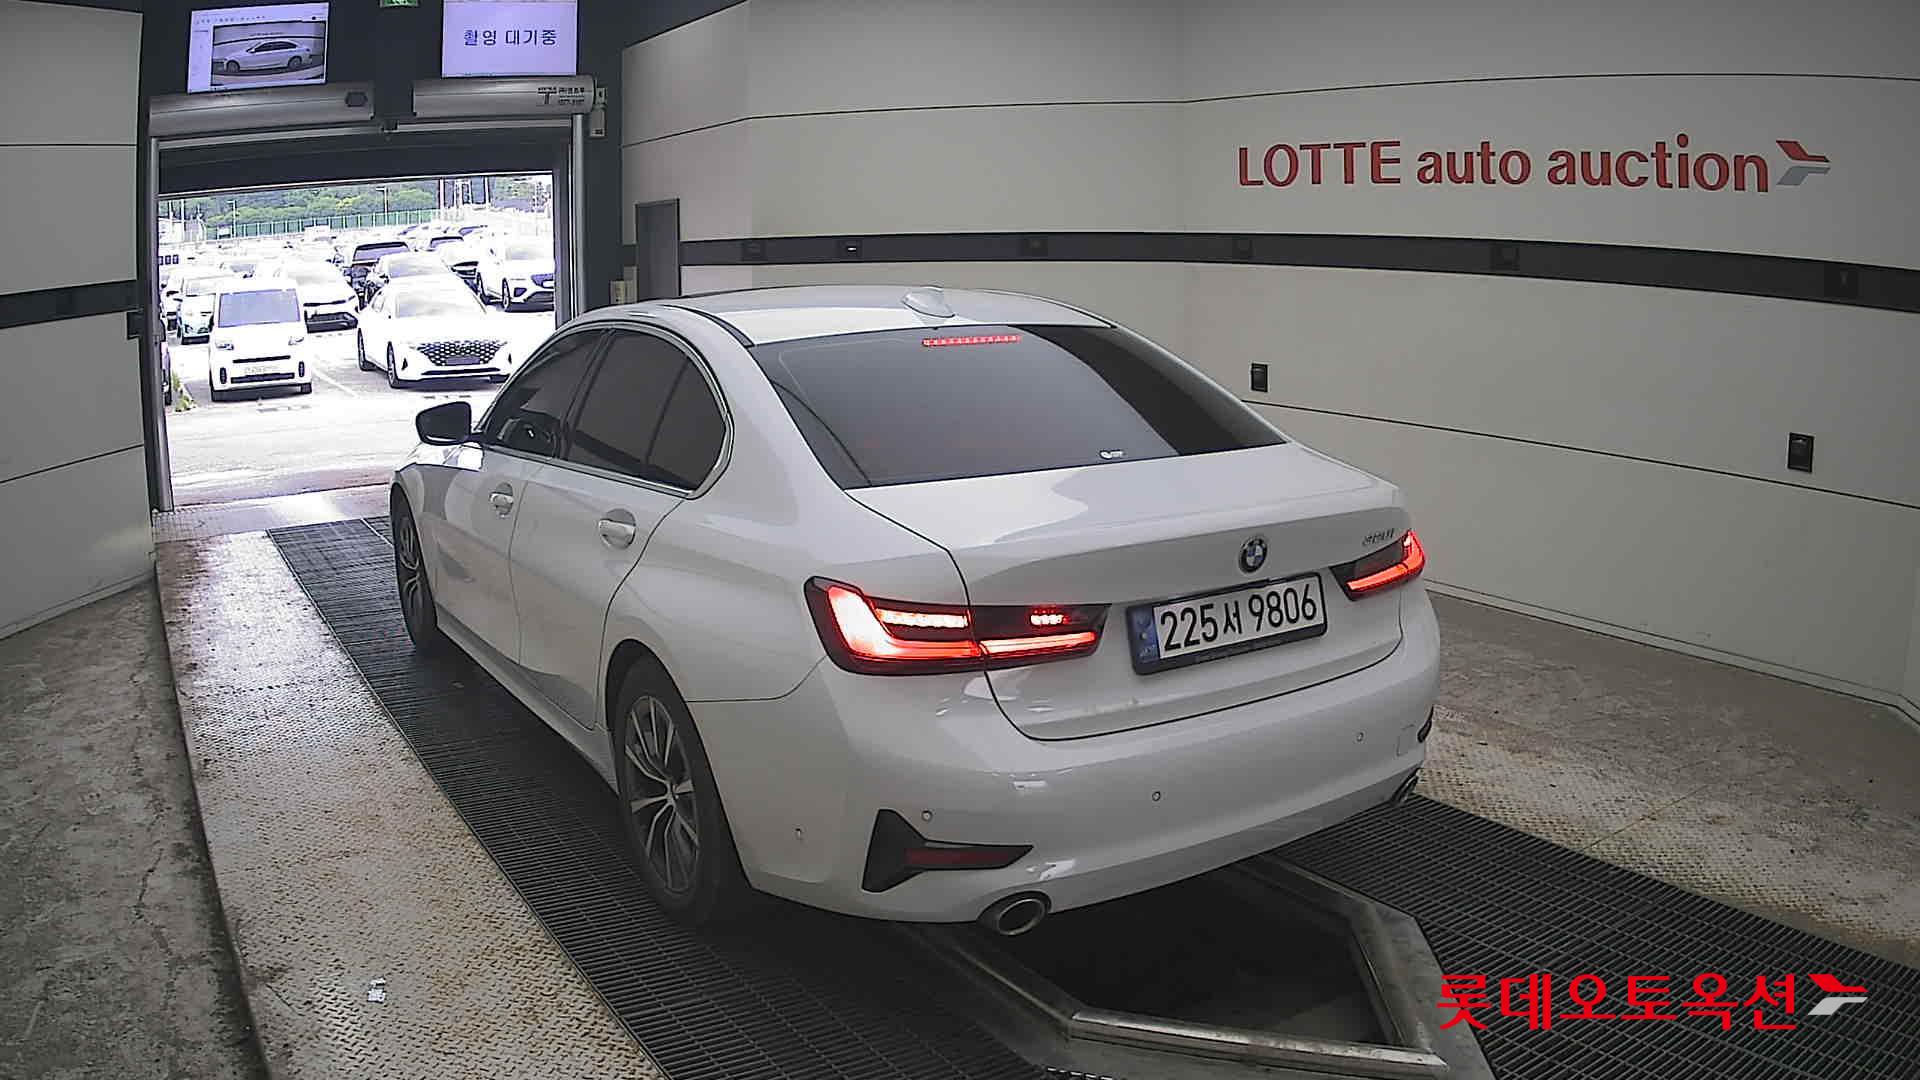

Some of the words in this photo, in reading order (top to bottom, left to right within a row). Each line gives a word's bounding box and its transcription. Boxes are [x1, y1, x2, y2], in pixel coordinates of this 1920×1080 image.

[505, 29, 557, 46] 대기중
[1239, 141, 1401, 187] LOTTE
[1416, 140, 1532, 185] auto
[1546, 133, 1770, 193] auction
[1160, 600, 1243, 651] 225서
[1248, 583, 1317, 632] 9806
